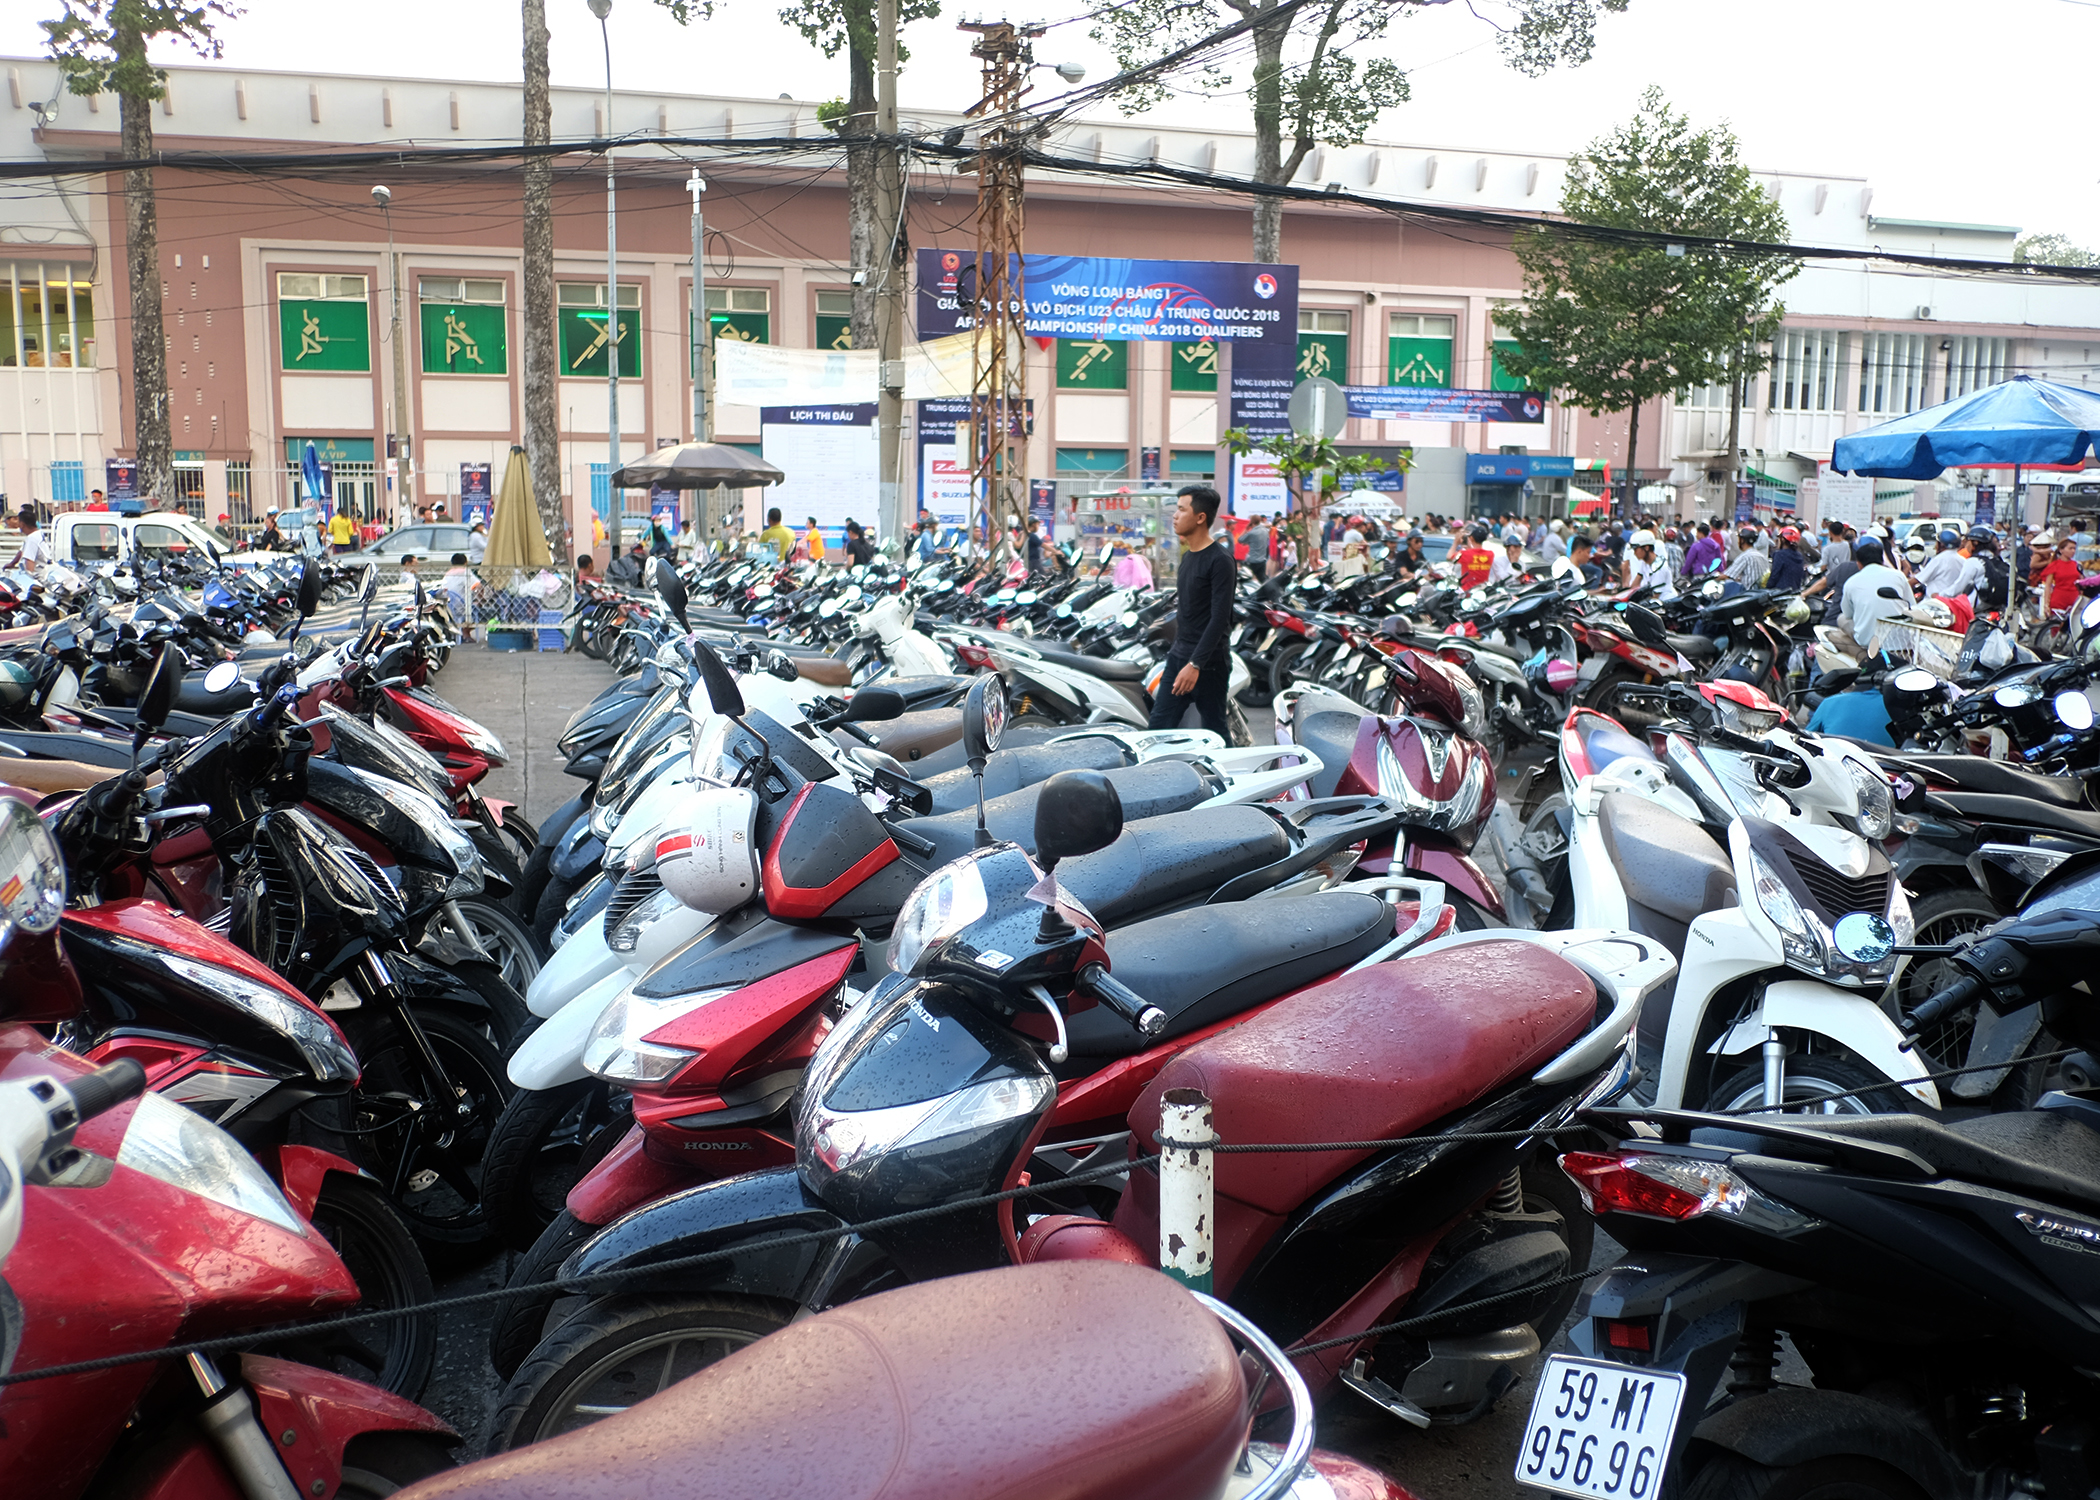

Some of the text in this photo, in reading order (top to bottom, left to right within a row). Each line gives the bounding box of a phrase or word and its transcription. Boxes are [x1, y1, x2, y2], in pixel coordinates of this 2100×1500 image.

[1051, 283, 1170, 301] VÒNG LOẠI BẢNG I
[1031, 300, 1052, 315] VÔ
[1053, 304, 1086, 318] ĐỊCH
[1088, 305, 1112, 317] U23
[1115, 304, 1151, 318] CHÂU
[1154, 305, 1164, 319] Á
[1166, 307, 1211, 320] TRUNG
[1213, 306, 1250, 321] QUỐC
[1252, 309, 1281, 322] 2018
[1016, 319, 1117, 334] HAMPIONSHIP
[1118, 324, 1158, 335] CHINA
[1160, 324, 1191, 336] 2018
[1192, 325, 1264, 338] QUALIFIERS
[790, 410, 813, 422] LỊCH
[815, 410, 831, 420] THI
[925, 404, 947, 412] TRUNG
[326, 439, 336, 450] A
[329, 451, 347, 459] VIP
[1477, 465, 1496, 475] ACB
[1692, 927, 1715, 947] HONDA
[907, 994, 941, 1033] HONDA
[683, 1141, 755, 1151] HONDA
[1555, 1368, 1655, 1434] 59-M1
[1527, 1425, 1655, 1500] 956.96
